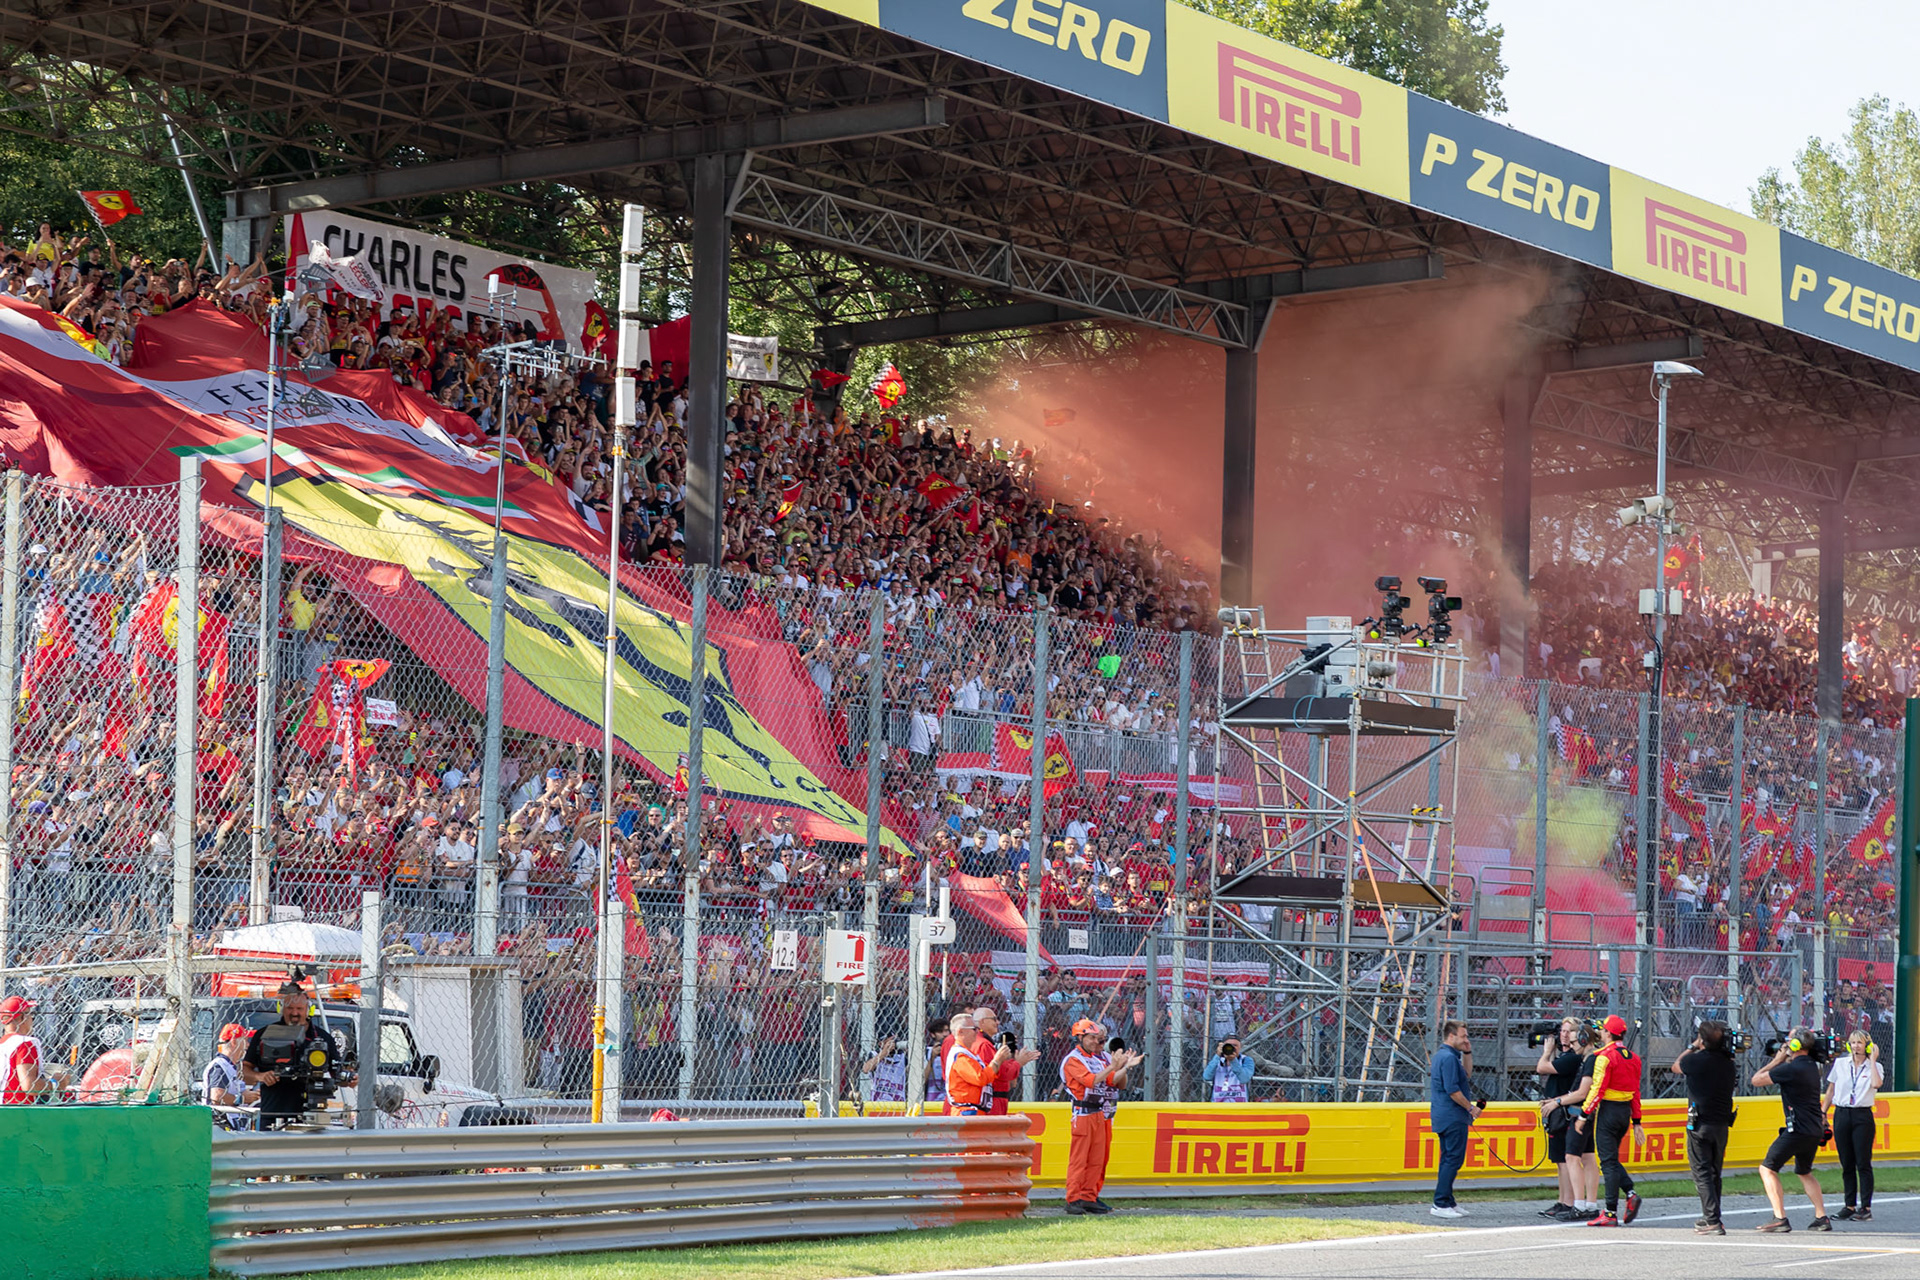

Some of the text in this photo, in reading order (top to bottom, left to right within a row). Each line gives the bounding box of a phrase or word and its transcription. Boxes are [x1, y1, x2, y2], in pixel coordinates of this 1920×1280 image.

[1218, 41, 1361, 166] PIRELLI
[1420, 132, 1600, 232] P ZERO
[323, 225, 468, 301] CHARLES
[349, 260, 374, 291] LECLER
[1645, 197, 1748, 295] PIRELLI
[1790, 264, 1920, 343] P ZERO
[206, 380, 379, 419] FERRI
[775, 947, 795, 967] 12.2
[930, 925, 946, 936] 37
[836, 961, 864, 970] FIRE
[1153, 1112, 1310, 1174] PIRELLI
[1404, 1111, 1537, 1169] PIELLI
